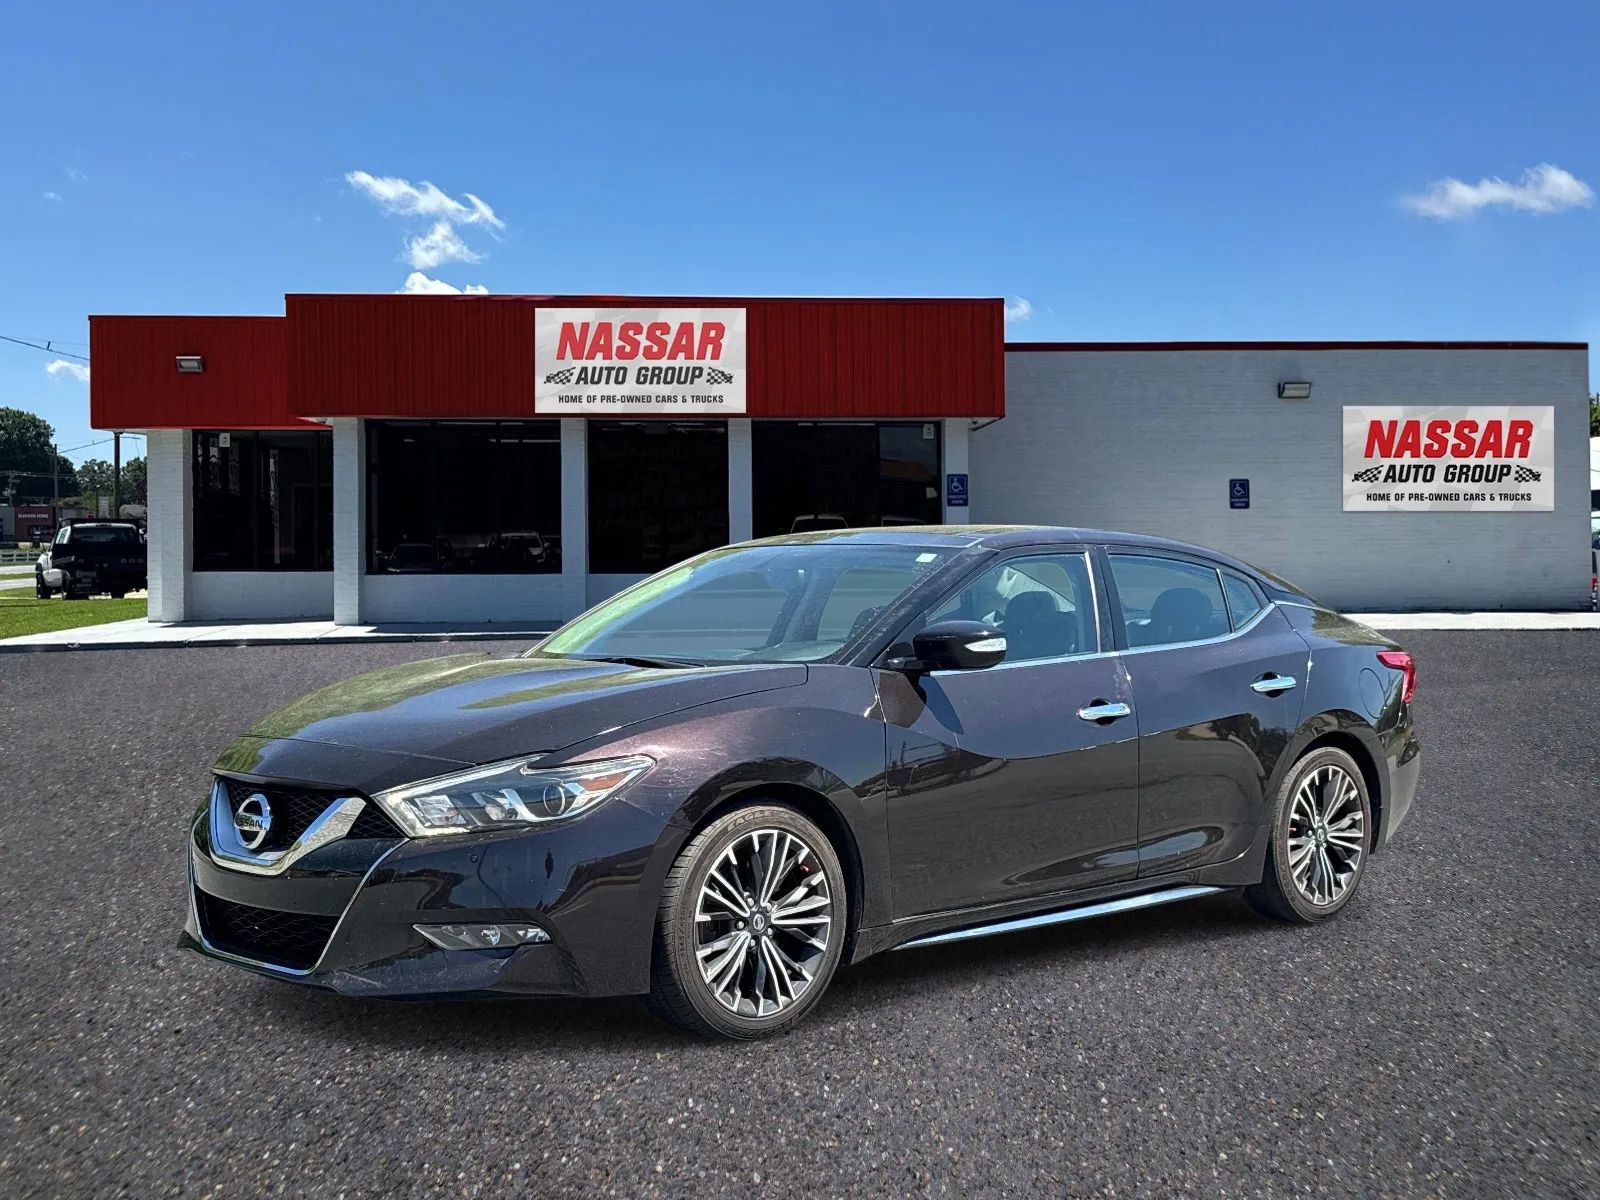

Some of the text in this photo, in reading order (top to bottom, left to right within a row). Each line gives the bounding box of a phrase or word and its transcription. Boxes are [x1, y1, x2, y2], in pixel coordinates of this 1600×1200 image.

[556, 321, 726, 361] NASSAR
[574, 366, 704, 385] AUTO GROUP
[558, 394, 724, 404] HOME OF PRE-OWNED CARS & TRUCKS
[1363, 419, 1534, 459] NASSAR
[1382, 464, 1513, 484] AUTO GROUP
[1366, 492, 1532, 502] HOME OF PRE-OWNED CARS & TRUCKS
[236, 816, 263, 829] SSAN
